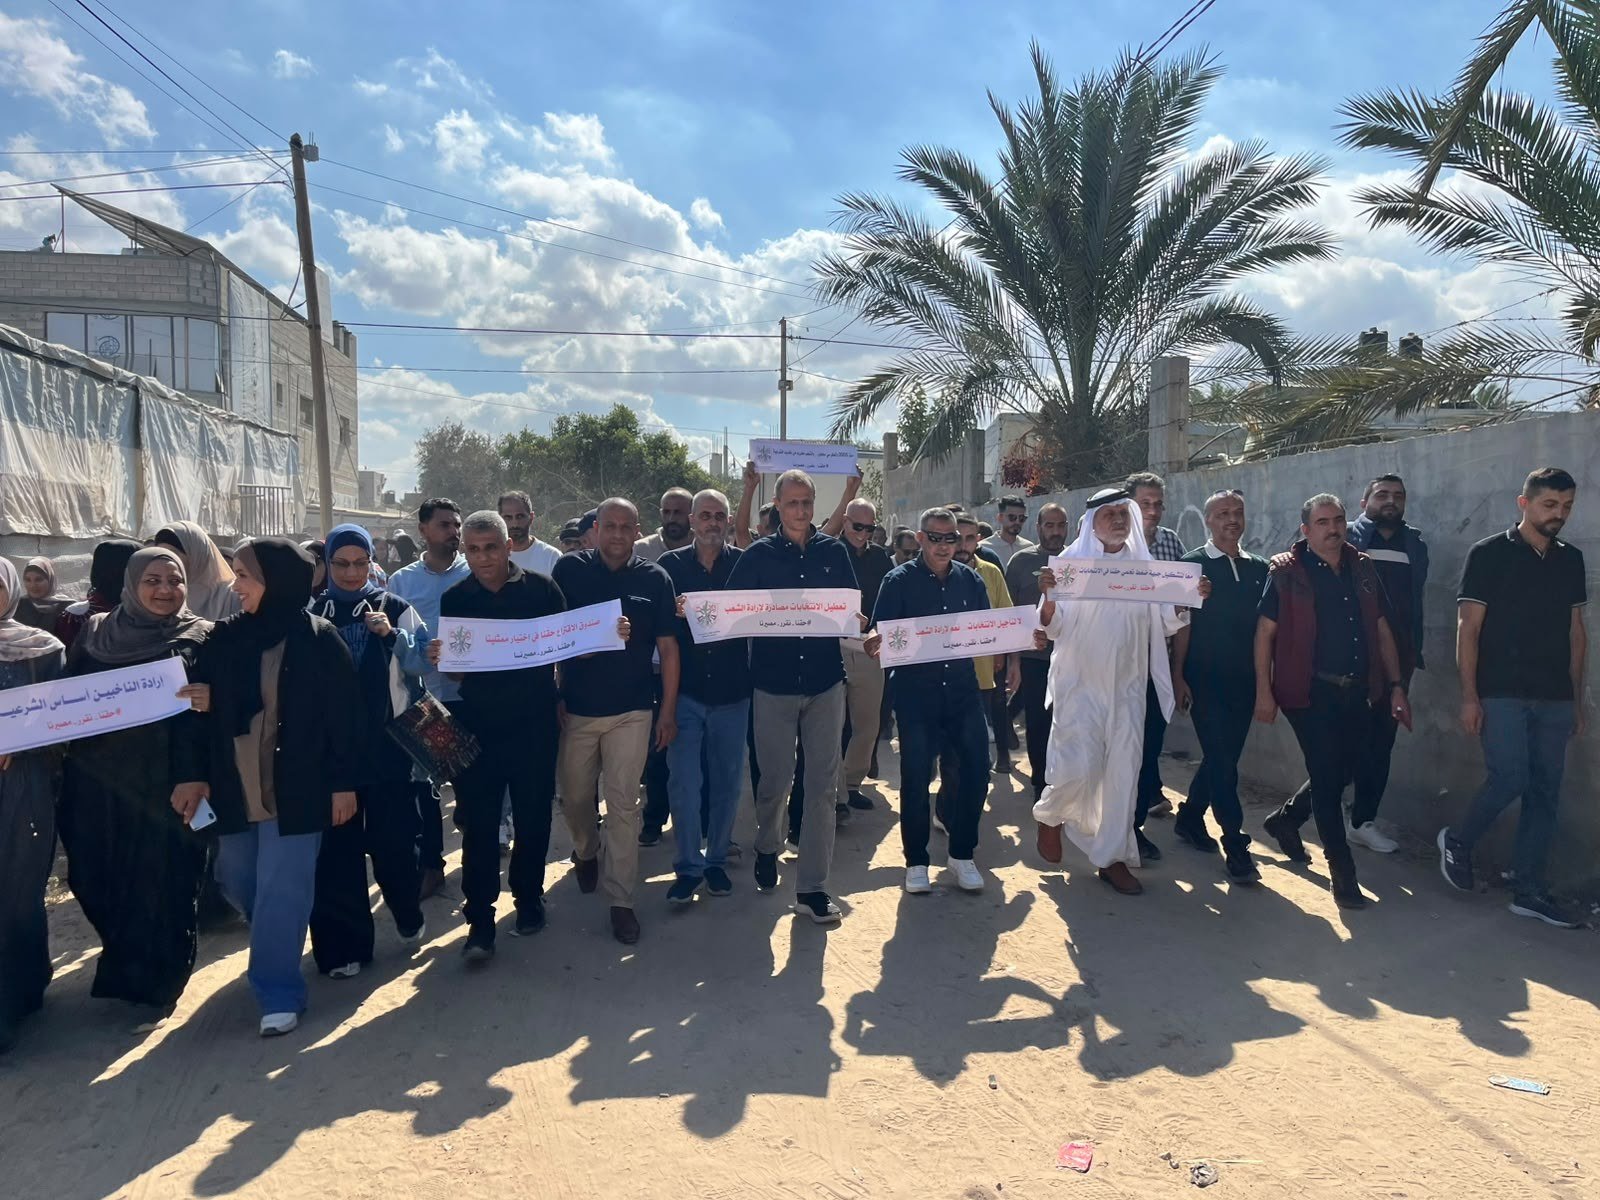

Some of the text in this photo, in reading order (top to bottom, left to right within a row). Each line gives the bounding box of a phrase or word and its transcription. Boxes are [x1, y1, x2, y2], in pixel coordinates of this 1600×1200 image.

[725, 603, 745, 614] الشعب
[765, 603, 789, 612] مصادرة
[790, 602, 823, 611] الانتخابات
[824, 602, 847, 612] تعطيل
[485, 619, 600, 645] صندوق الاقتراع حقنا في اختيار ممثلينا
[916, 626, 933, 638] الشعب
[93, 682, 140, 702] الناخبين
[0, 698, 47, 719] الشرعي
